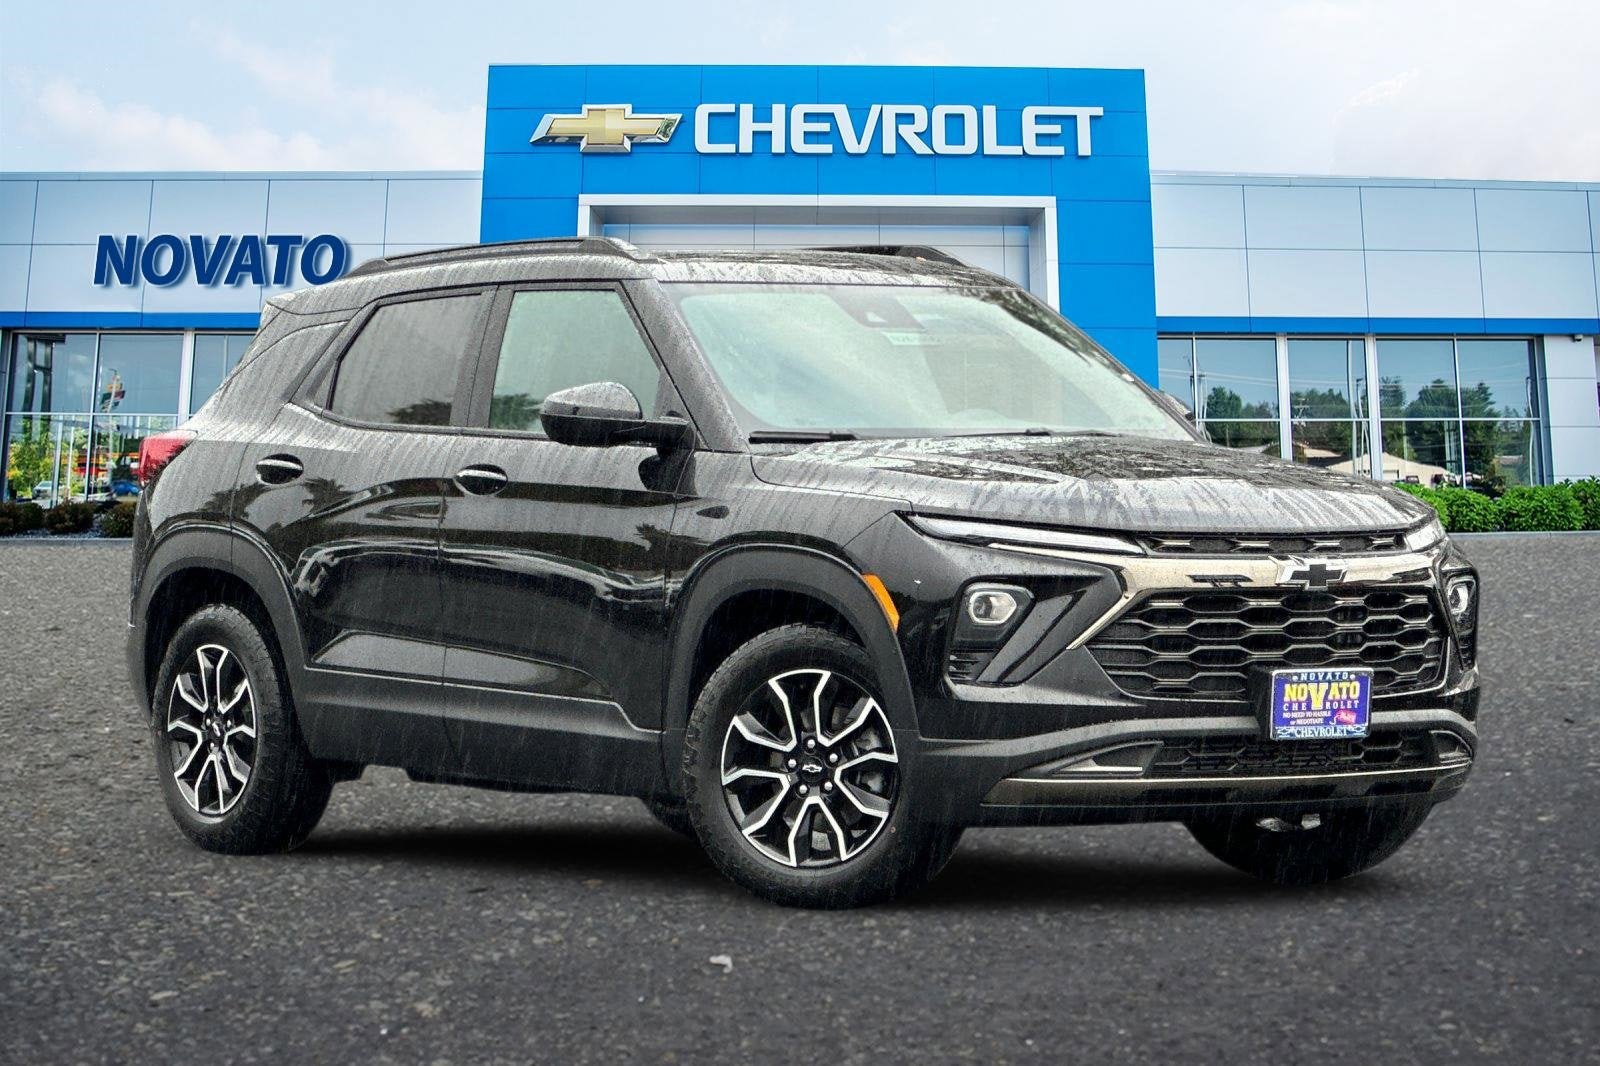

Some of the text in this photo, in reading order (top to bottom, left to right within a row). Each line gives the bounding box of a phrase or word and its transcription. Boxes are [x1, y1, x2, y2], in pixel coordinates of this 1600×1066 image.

[694, 103, 1104, 157] CHEVROLET
[93, 234, 347, 286] NOVATO
[1301, 672, 1348, 681] NOVATO
[1284, 681, 1360, 710] NOVATO
[1295, 727, 1348, 738] CHEVROLET
